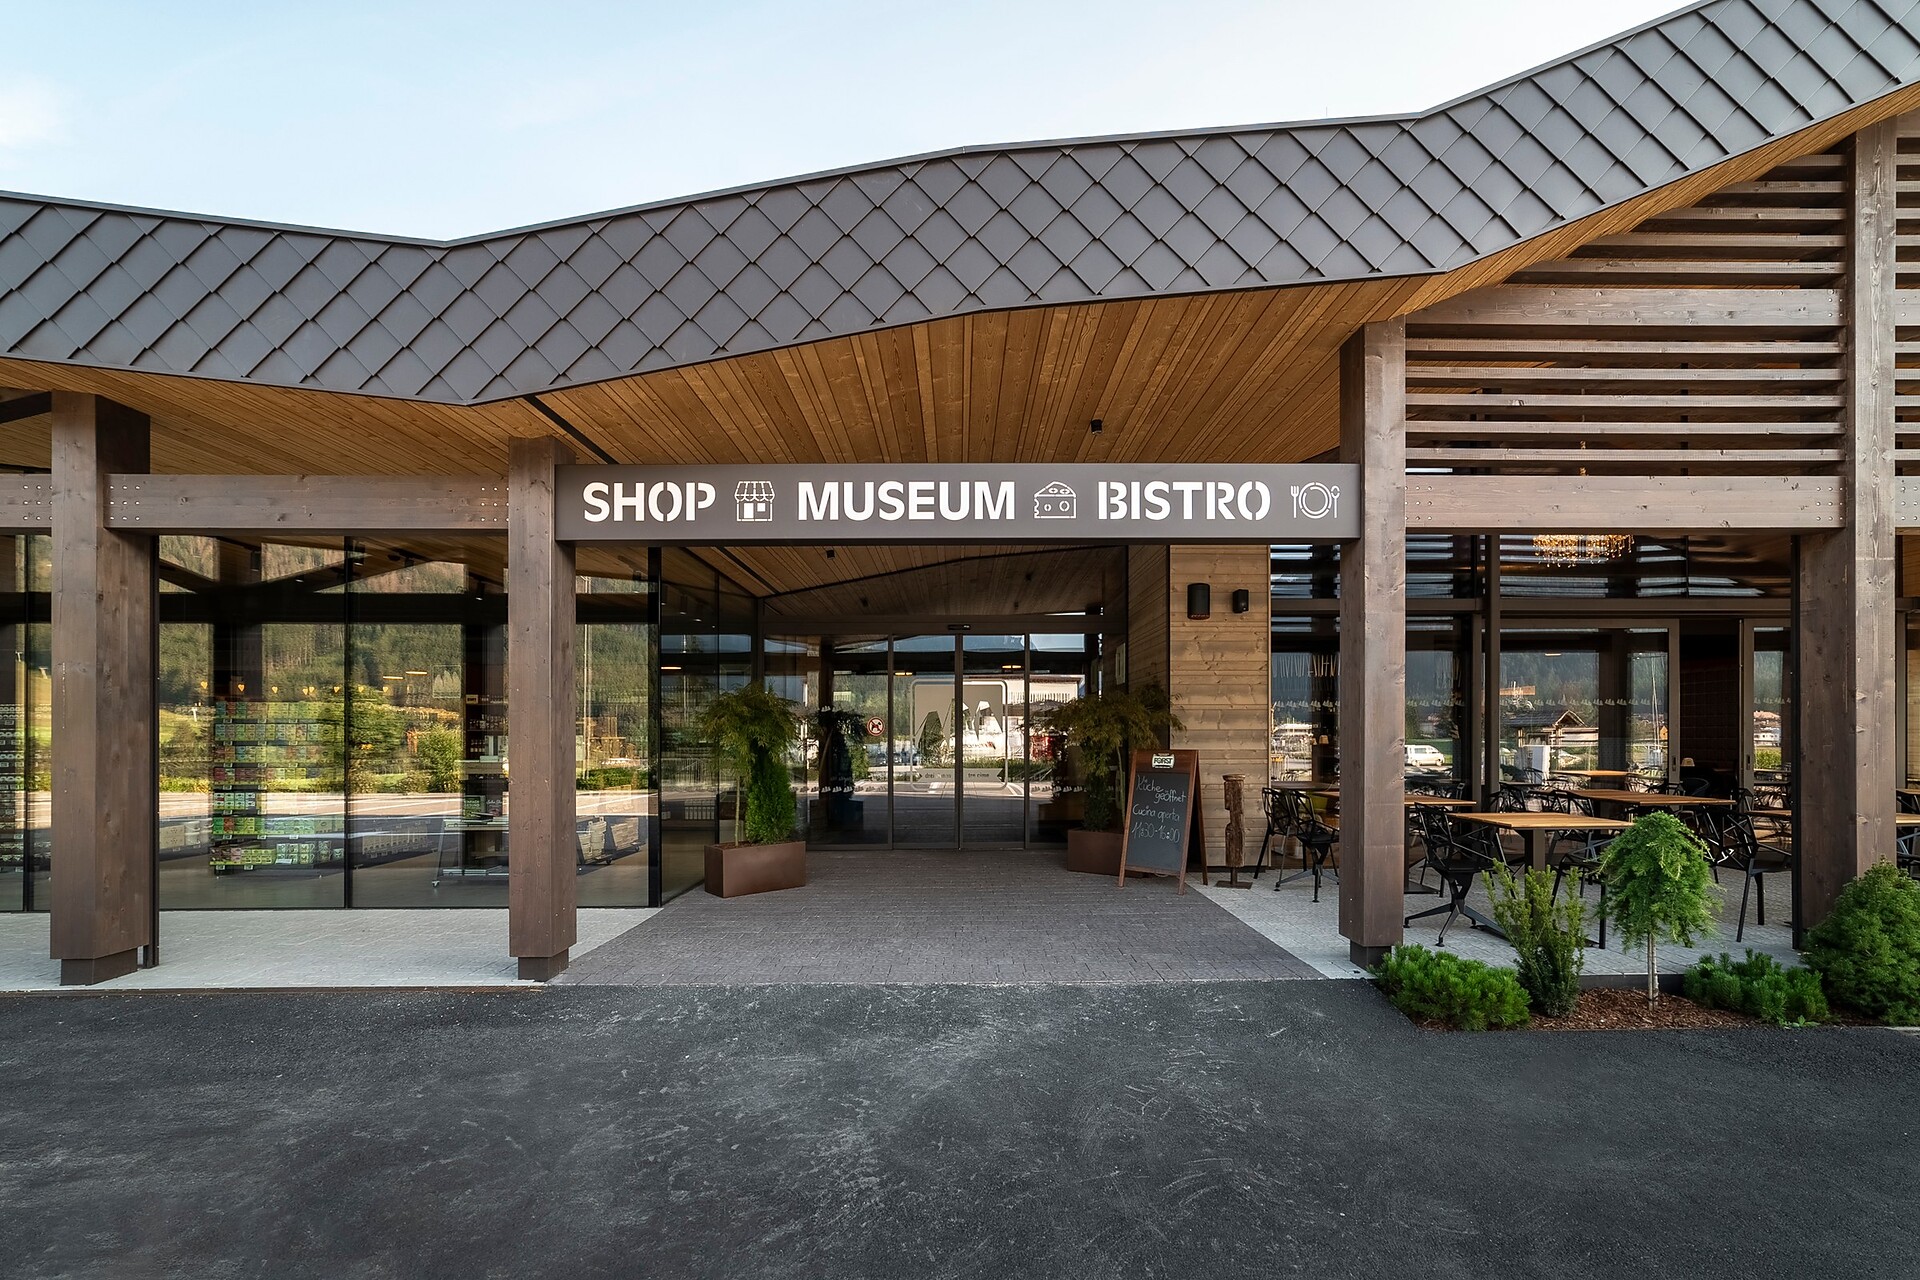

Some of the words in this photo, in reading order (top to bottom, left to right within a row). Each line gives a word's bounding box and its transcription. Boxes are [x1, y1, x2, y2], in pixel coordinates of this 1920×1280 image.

[583, 481, 716, 523] SHOP
[798, 480, 1015, 521] MUSEUM
[1098, 480, 1271, 521] BISTRO
[1136, 774, 1164, 792] Küche
[1153, 788, 1187, 804] geöffnet
[1132, 803, 1156, 817] Cucina
